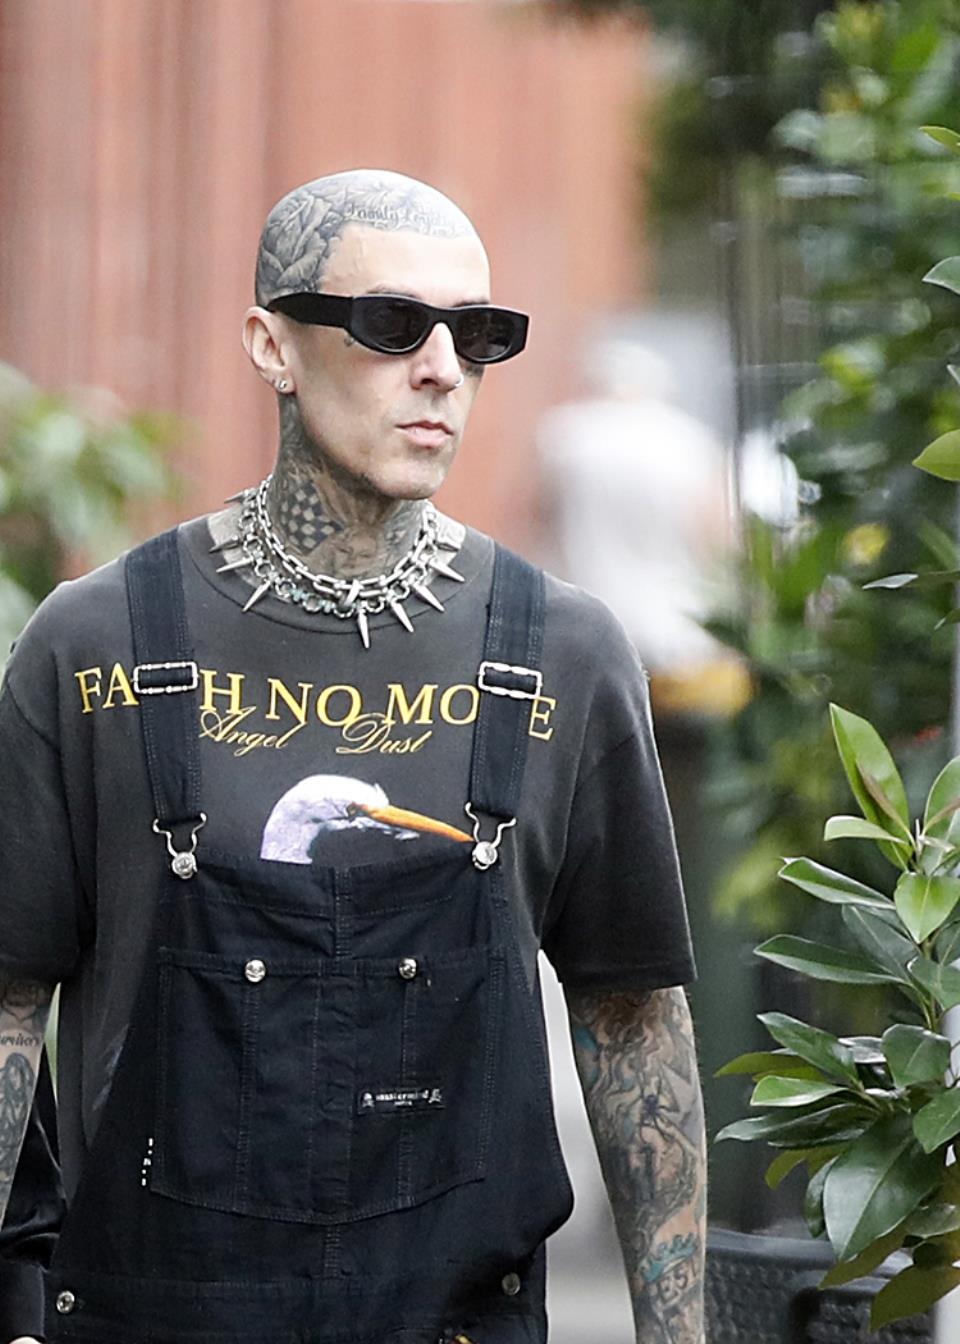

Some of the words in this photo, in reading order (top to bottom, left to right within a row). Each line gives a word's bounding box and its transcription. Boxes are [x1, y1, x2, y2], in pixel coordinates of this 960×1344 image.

[74, 661, 245, 715] FAH
[266, 679, 363, 728] NO
[384, 682, 558, 741] MOE
[198, 706, 306, 757] Angel
[335, 712, 432, 754] Dust
